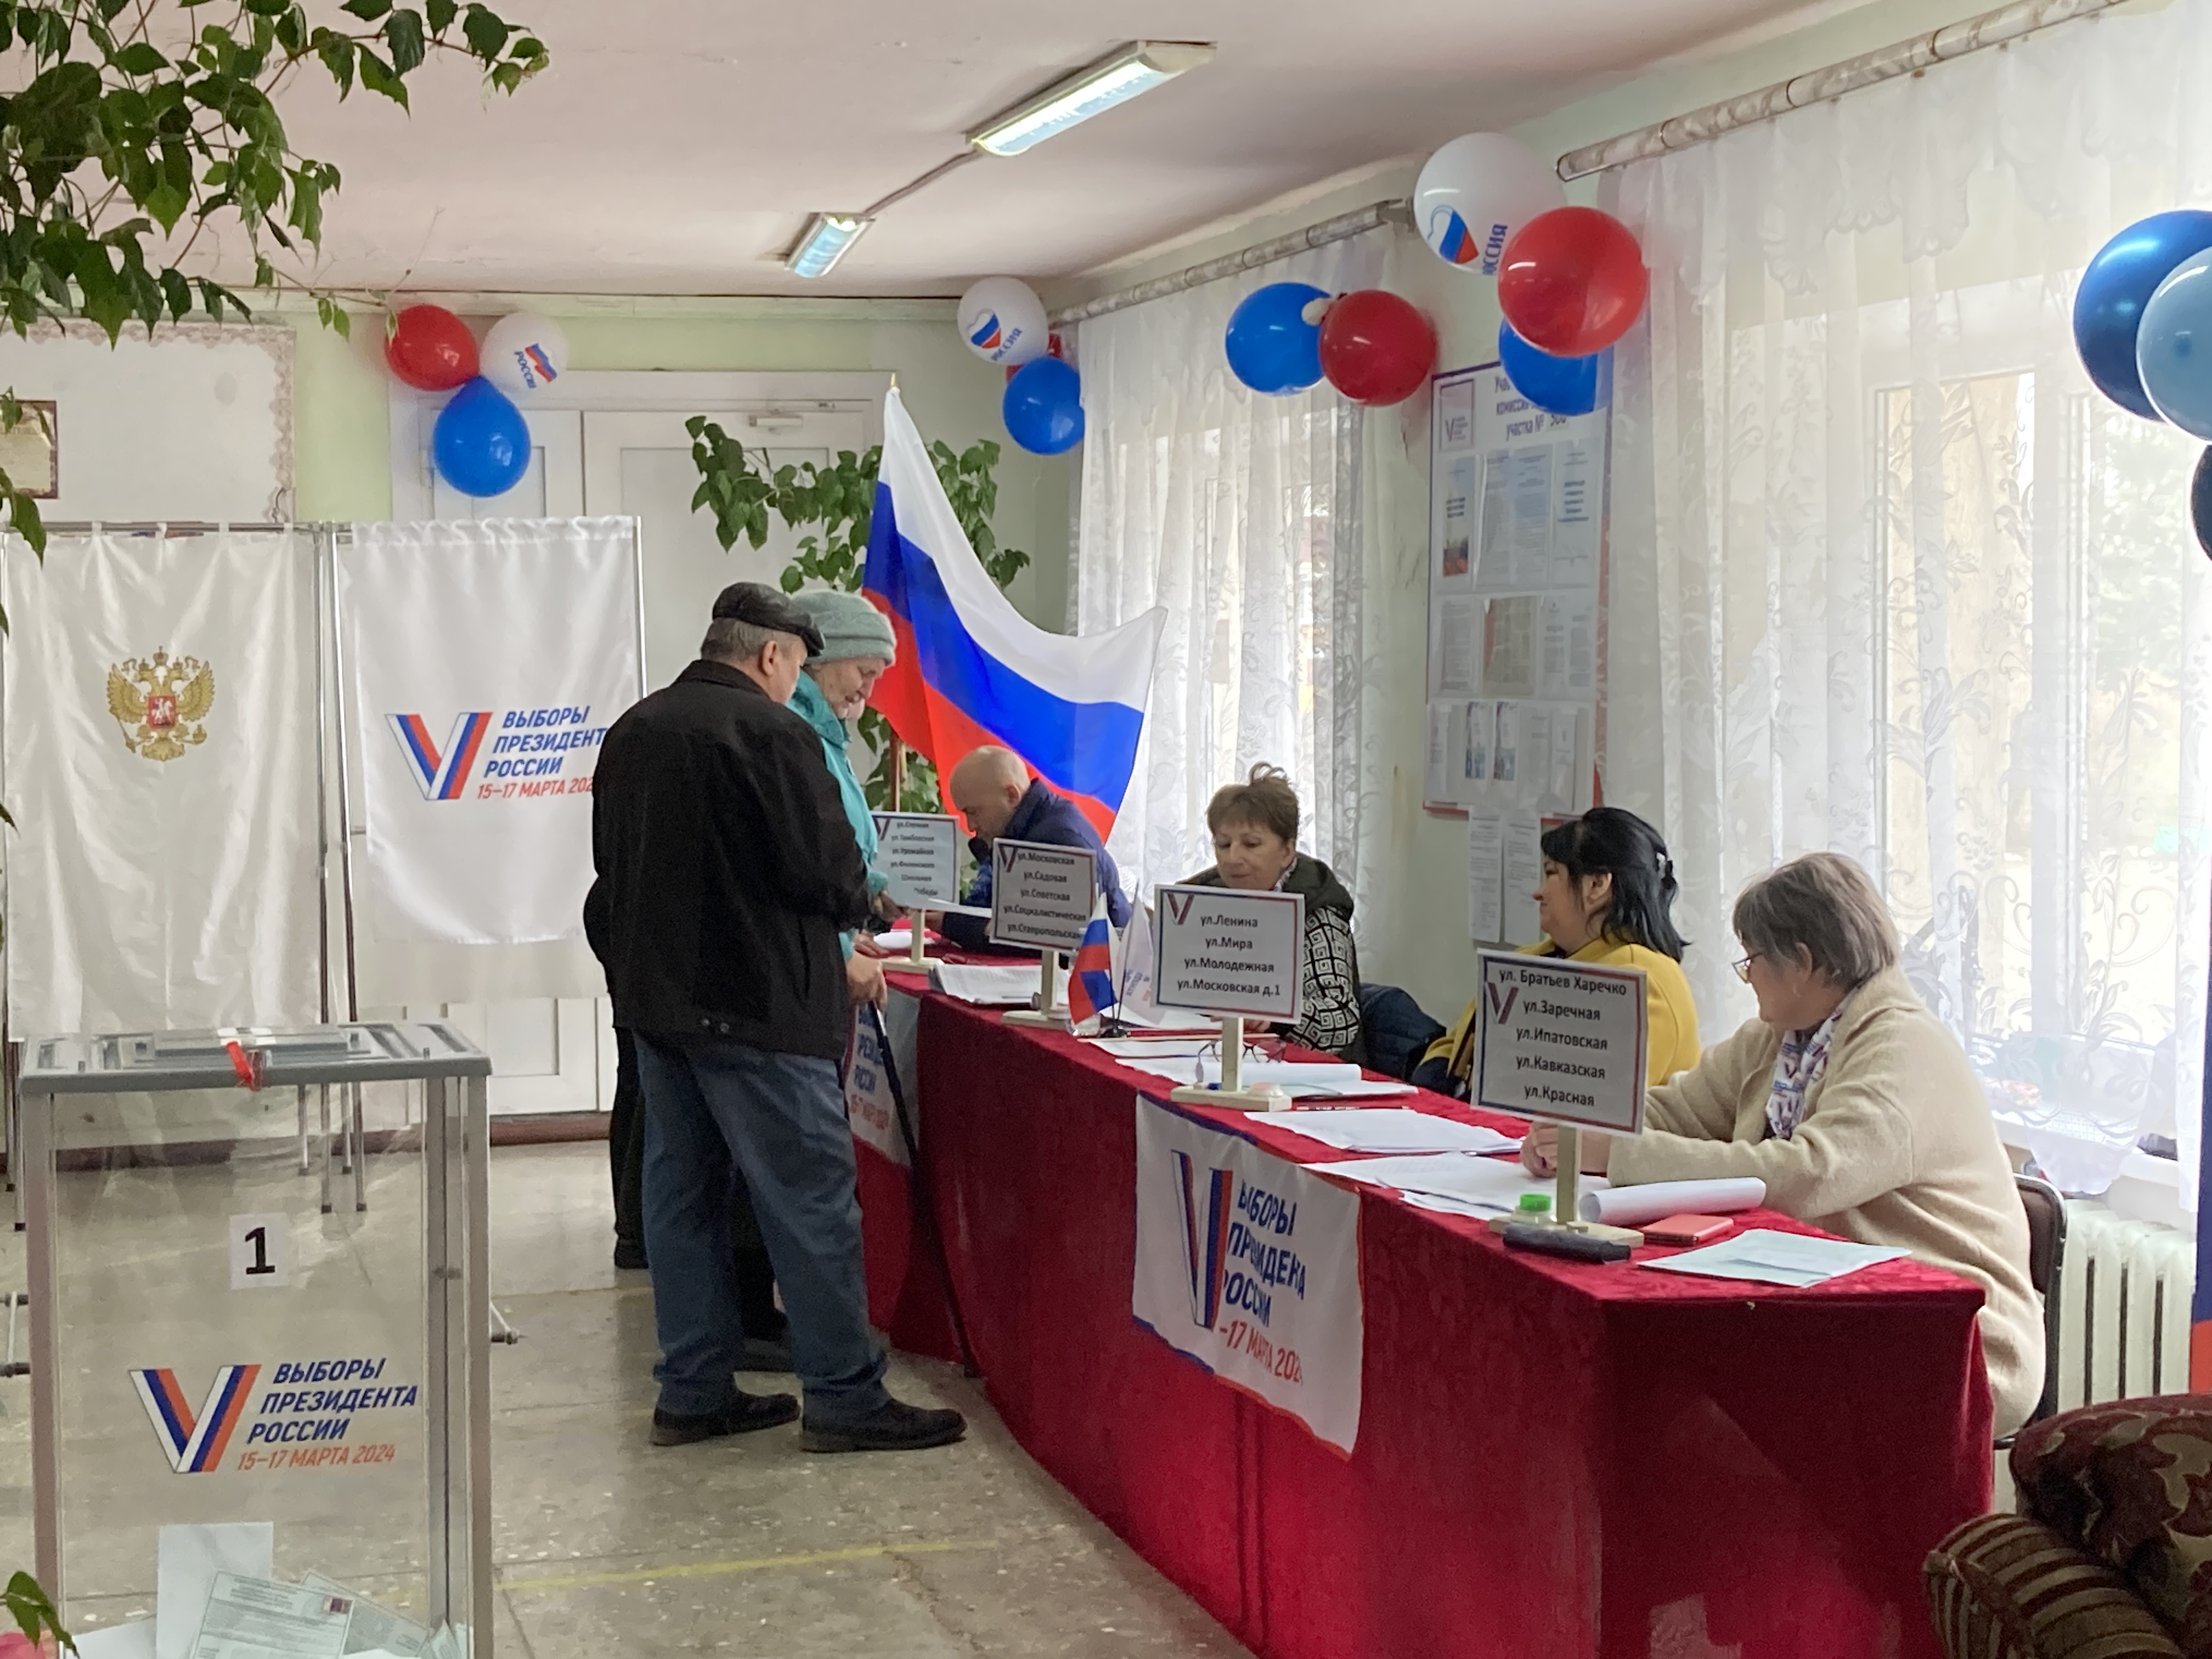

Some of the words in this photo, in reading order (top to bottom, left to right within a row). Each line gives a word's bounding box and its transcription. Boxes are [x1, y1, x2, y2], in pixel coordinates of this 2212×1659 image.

[503, 706, 590, 729] ВЫБОРЫ
[493, 728, 608, 753] ПРЕЗИДЕНТ
[484, 757, 563, 778] РОССИИ
[518, 780, 566, 797] МАРТА
[568, 777, 594, 794] 202
[1200, 915, 1258, 927] ул.Ленина
[1205, 937, 1252, 951] ул.Мира
[1184, 958, 1274, 973] ул.Молодежная
[1177, 979, 1260, 994] ул.Московская
[1499, 969, 1516, 983] ул.
[1521, 970, 1570, 988] Братьев
[1573, 976, 1627, 996] Харечко
[1523, 1000, 1600, 1021] ул.Заречная
[1516, 1027, 1607, 1051] ул.Ипатовская
[1516, 1055, 1605, 1080] ул.Кавказская
[1524, 1085, 1594, 1107] ул.Красная
[1238, 1179, 1297, 1237] ЫБОРЫ
[245, 1227, 275, 1275] 1
[273, 1358, 386, 1384] ВЫБОРЫ
[260, 1385, 418, 1414] ПРЕЗИДЕНТА
[247, 1418, 351, 1444] РОССИИ
[289, 1446, 349, 1467] МАРТА
[352, 1443, 396, 1464] 2024
